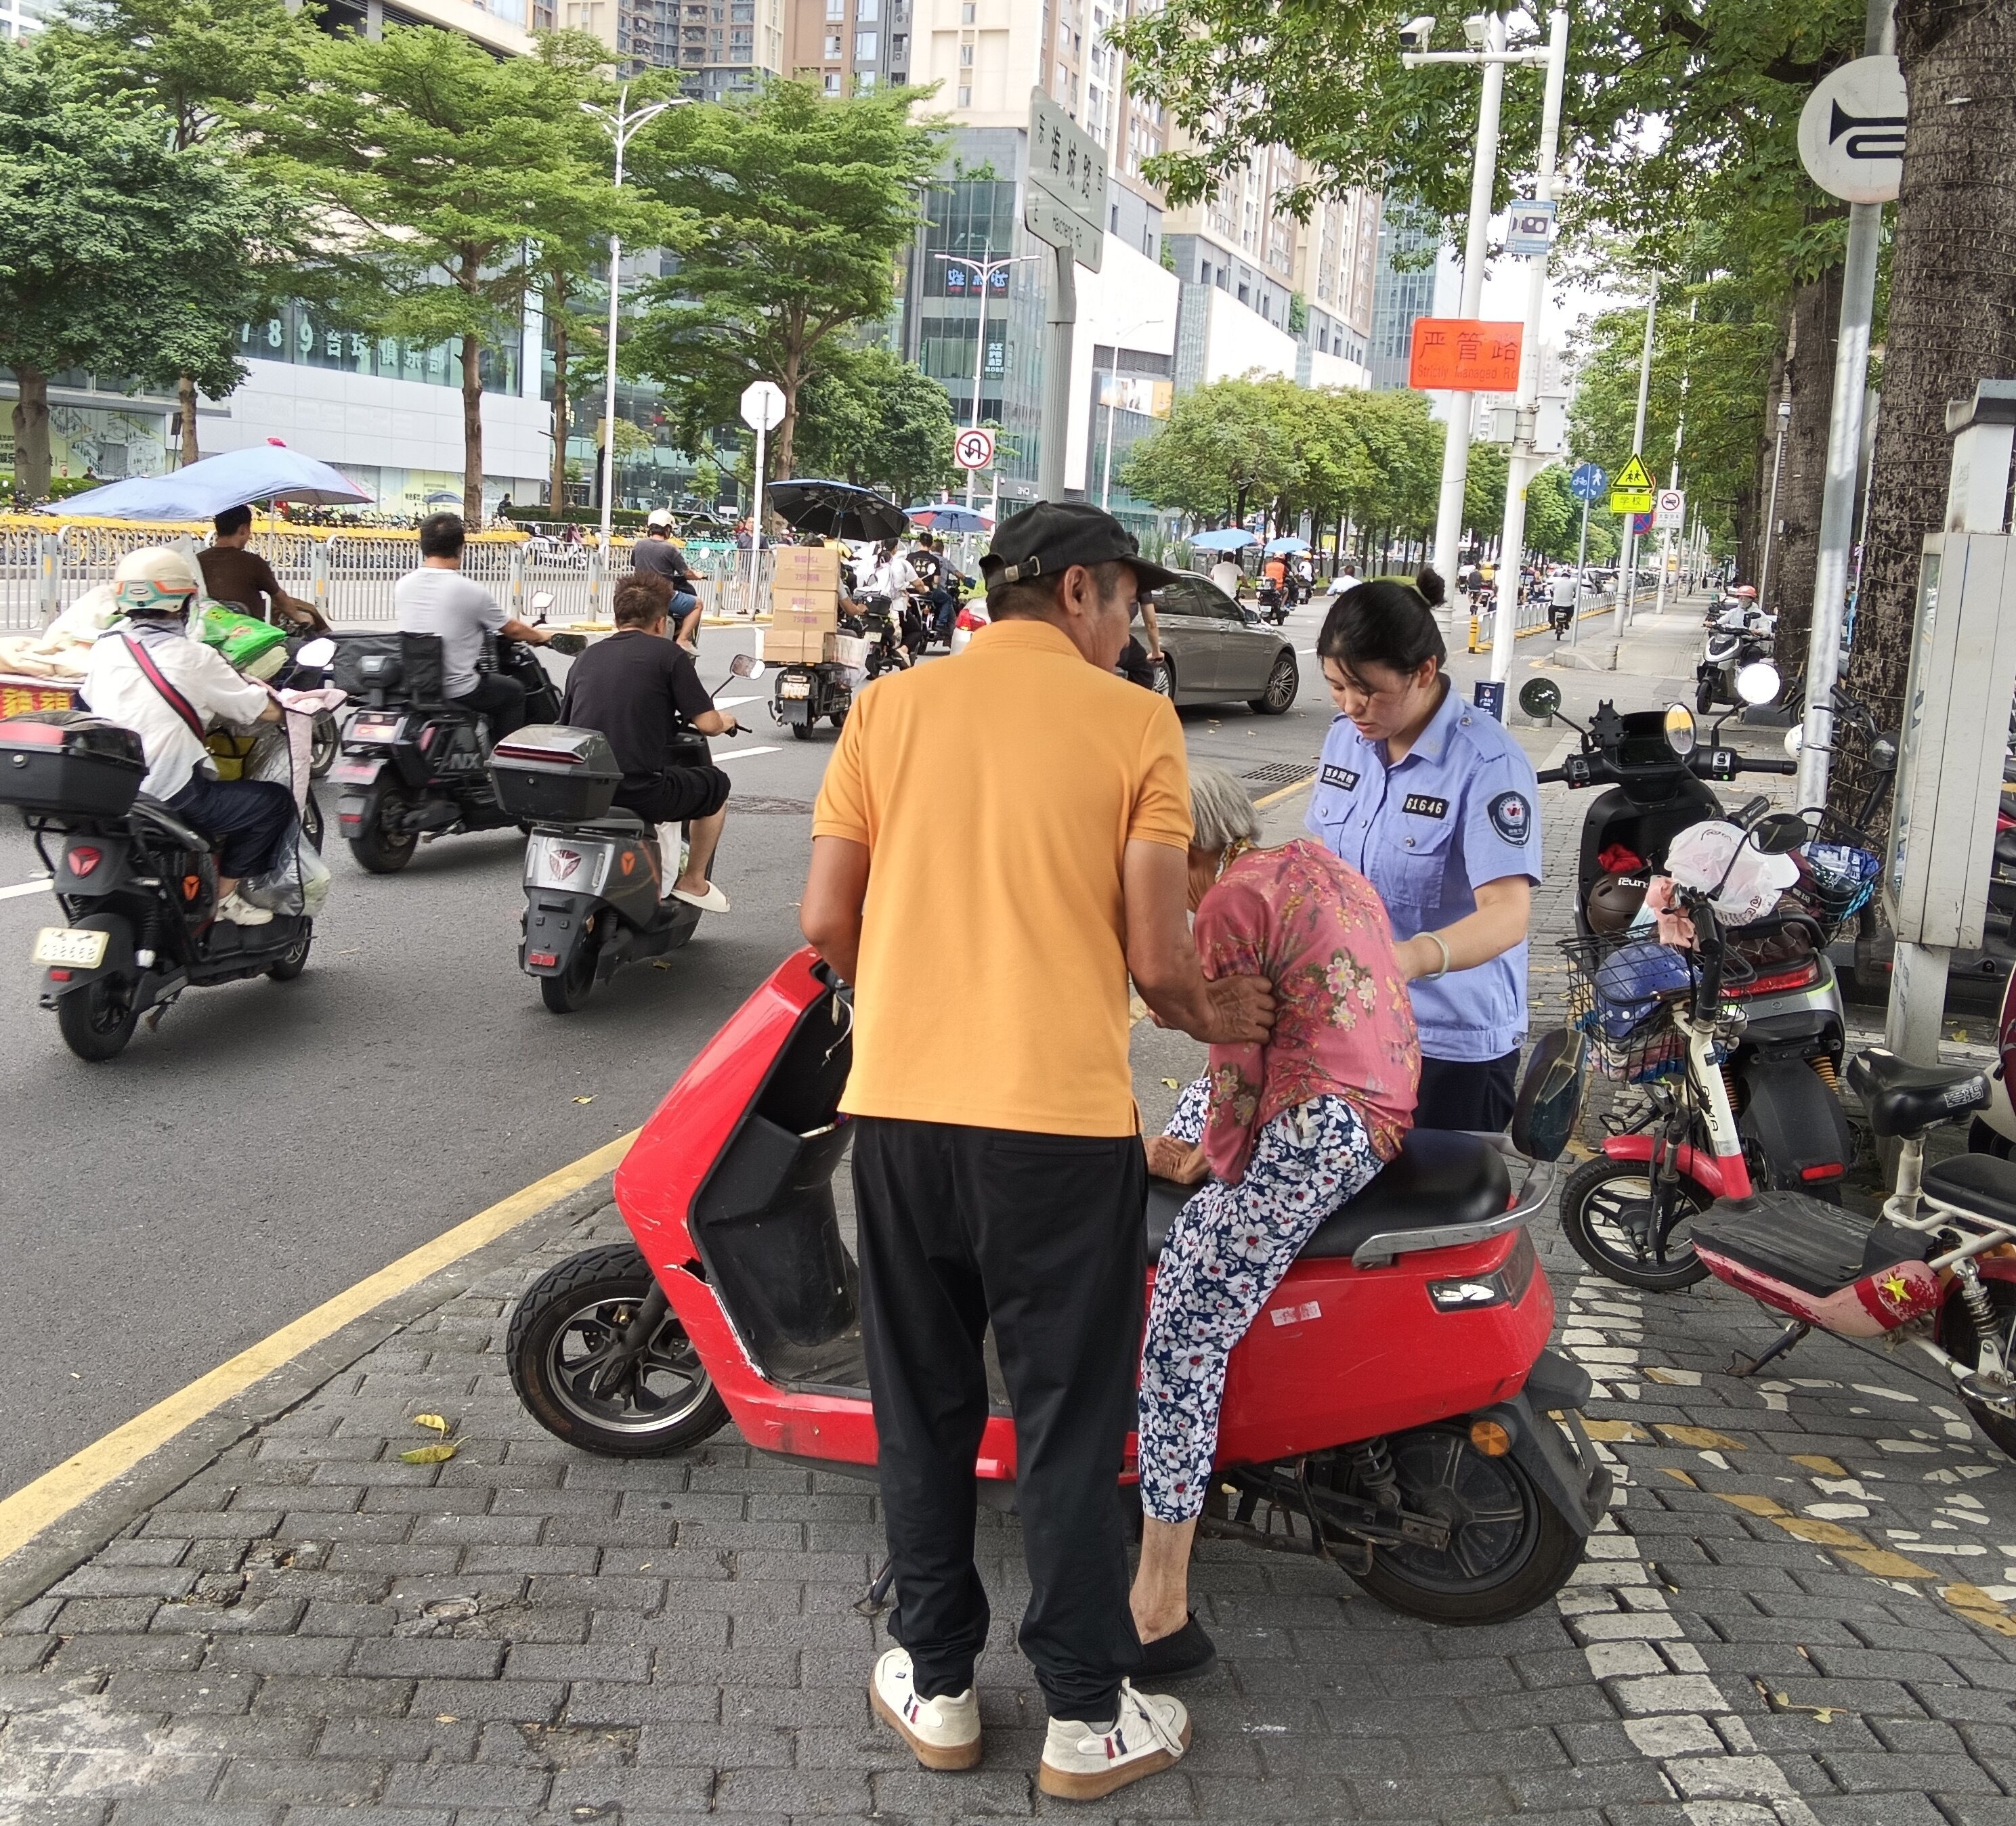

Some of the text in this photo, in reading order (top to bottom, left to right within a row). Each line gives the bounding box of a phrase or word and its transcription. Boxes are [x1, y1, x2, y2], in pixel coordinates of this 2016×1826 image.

[1050, 125, 1092, 201] 海城路
[1419, 330, 1518, 362] 严管路
[1418, 364, 1449, 381] Strictly
[1620, 496, 1642, 506] 学校
[1405, 798, 1443, 814] 61646
